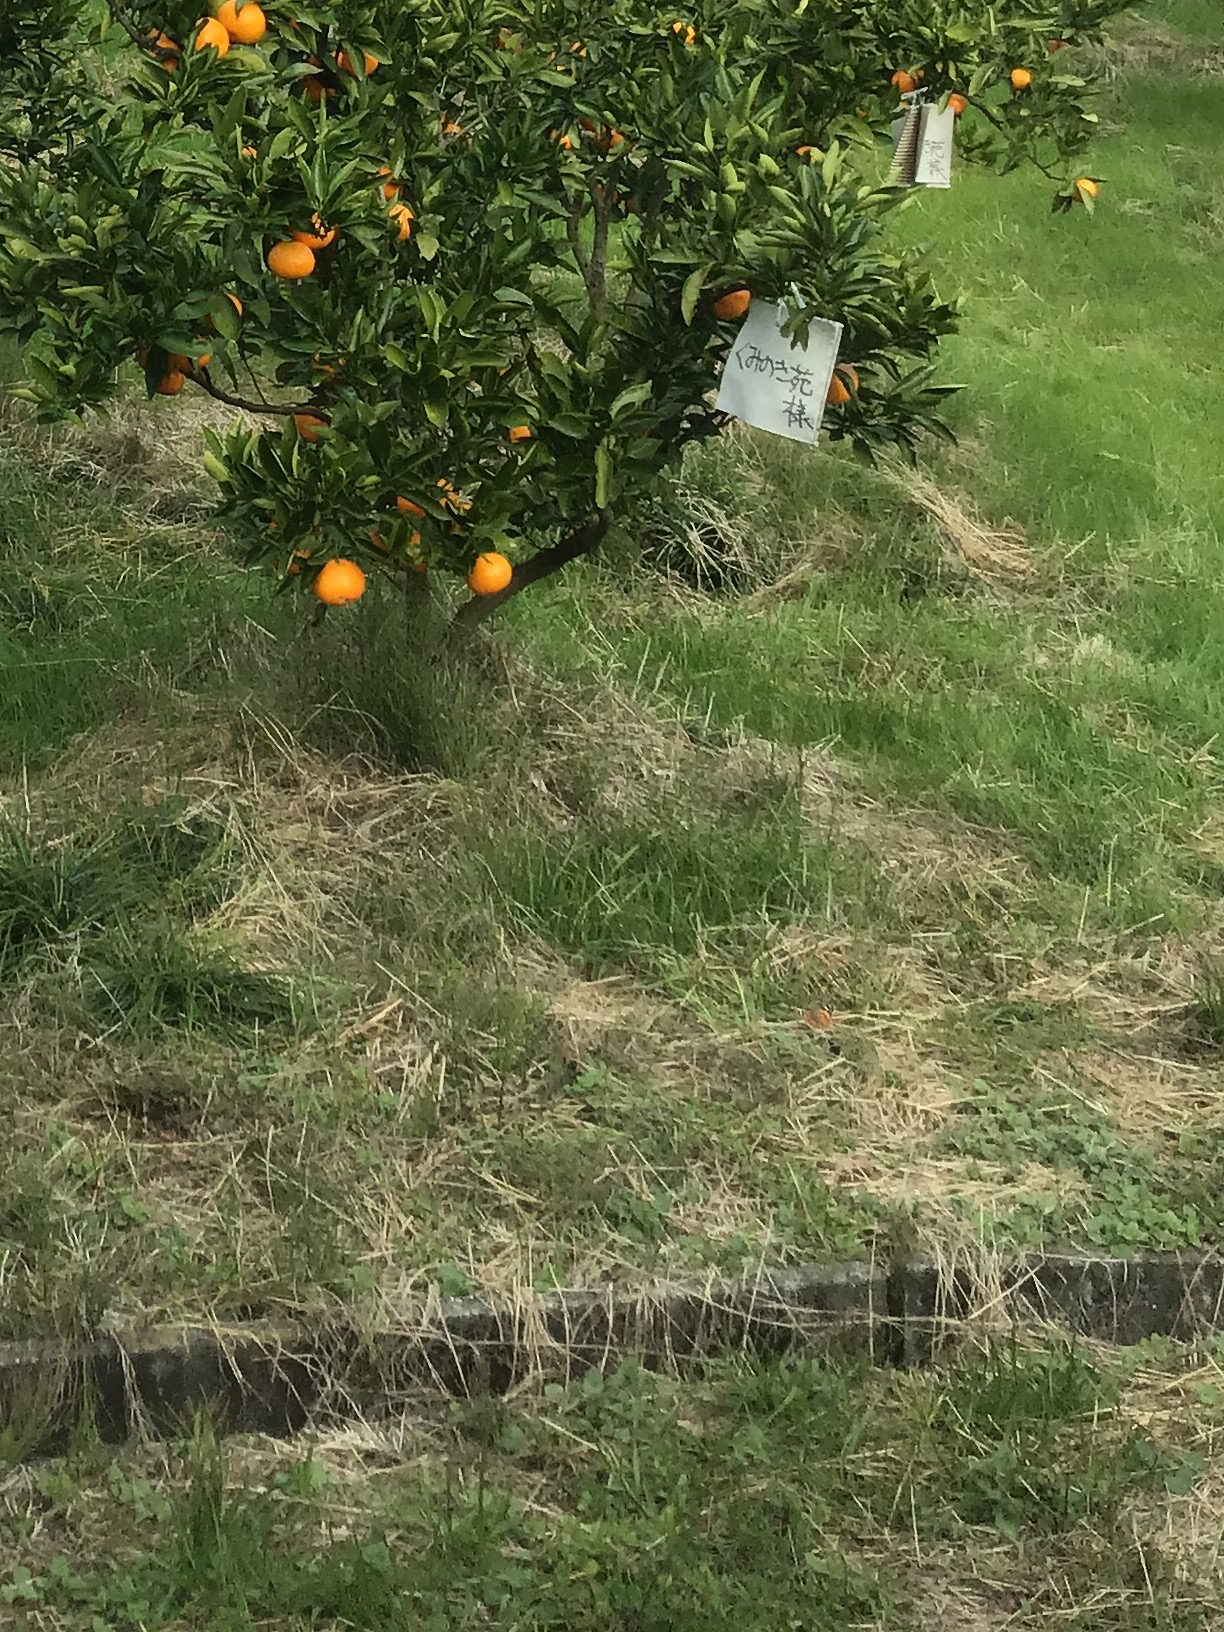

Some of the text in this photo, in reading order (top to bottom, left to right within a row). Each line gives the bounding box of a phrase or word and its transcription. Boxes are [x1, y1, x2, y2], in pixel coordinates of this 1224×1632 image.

[735, 341, 814, 397] くみのき苑
[781, 395, 814, 430] 様
